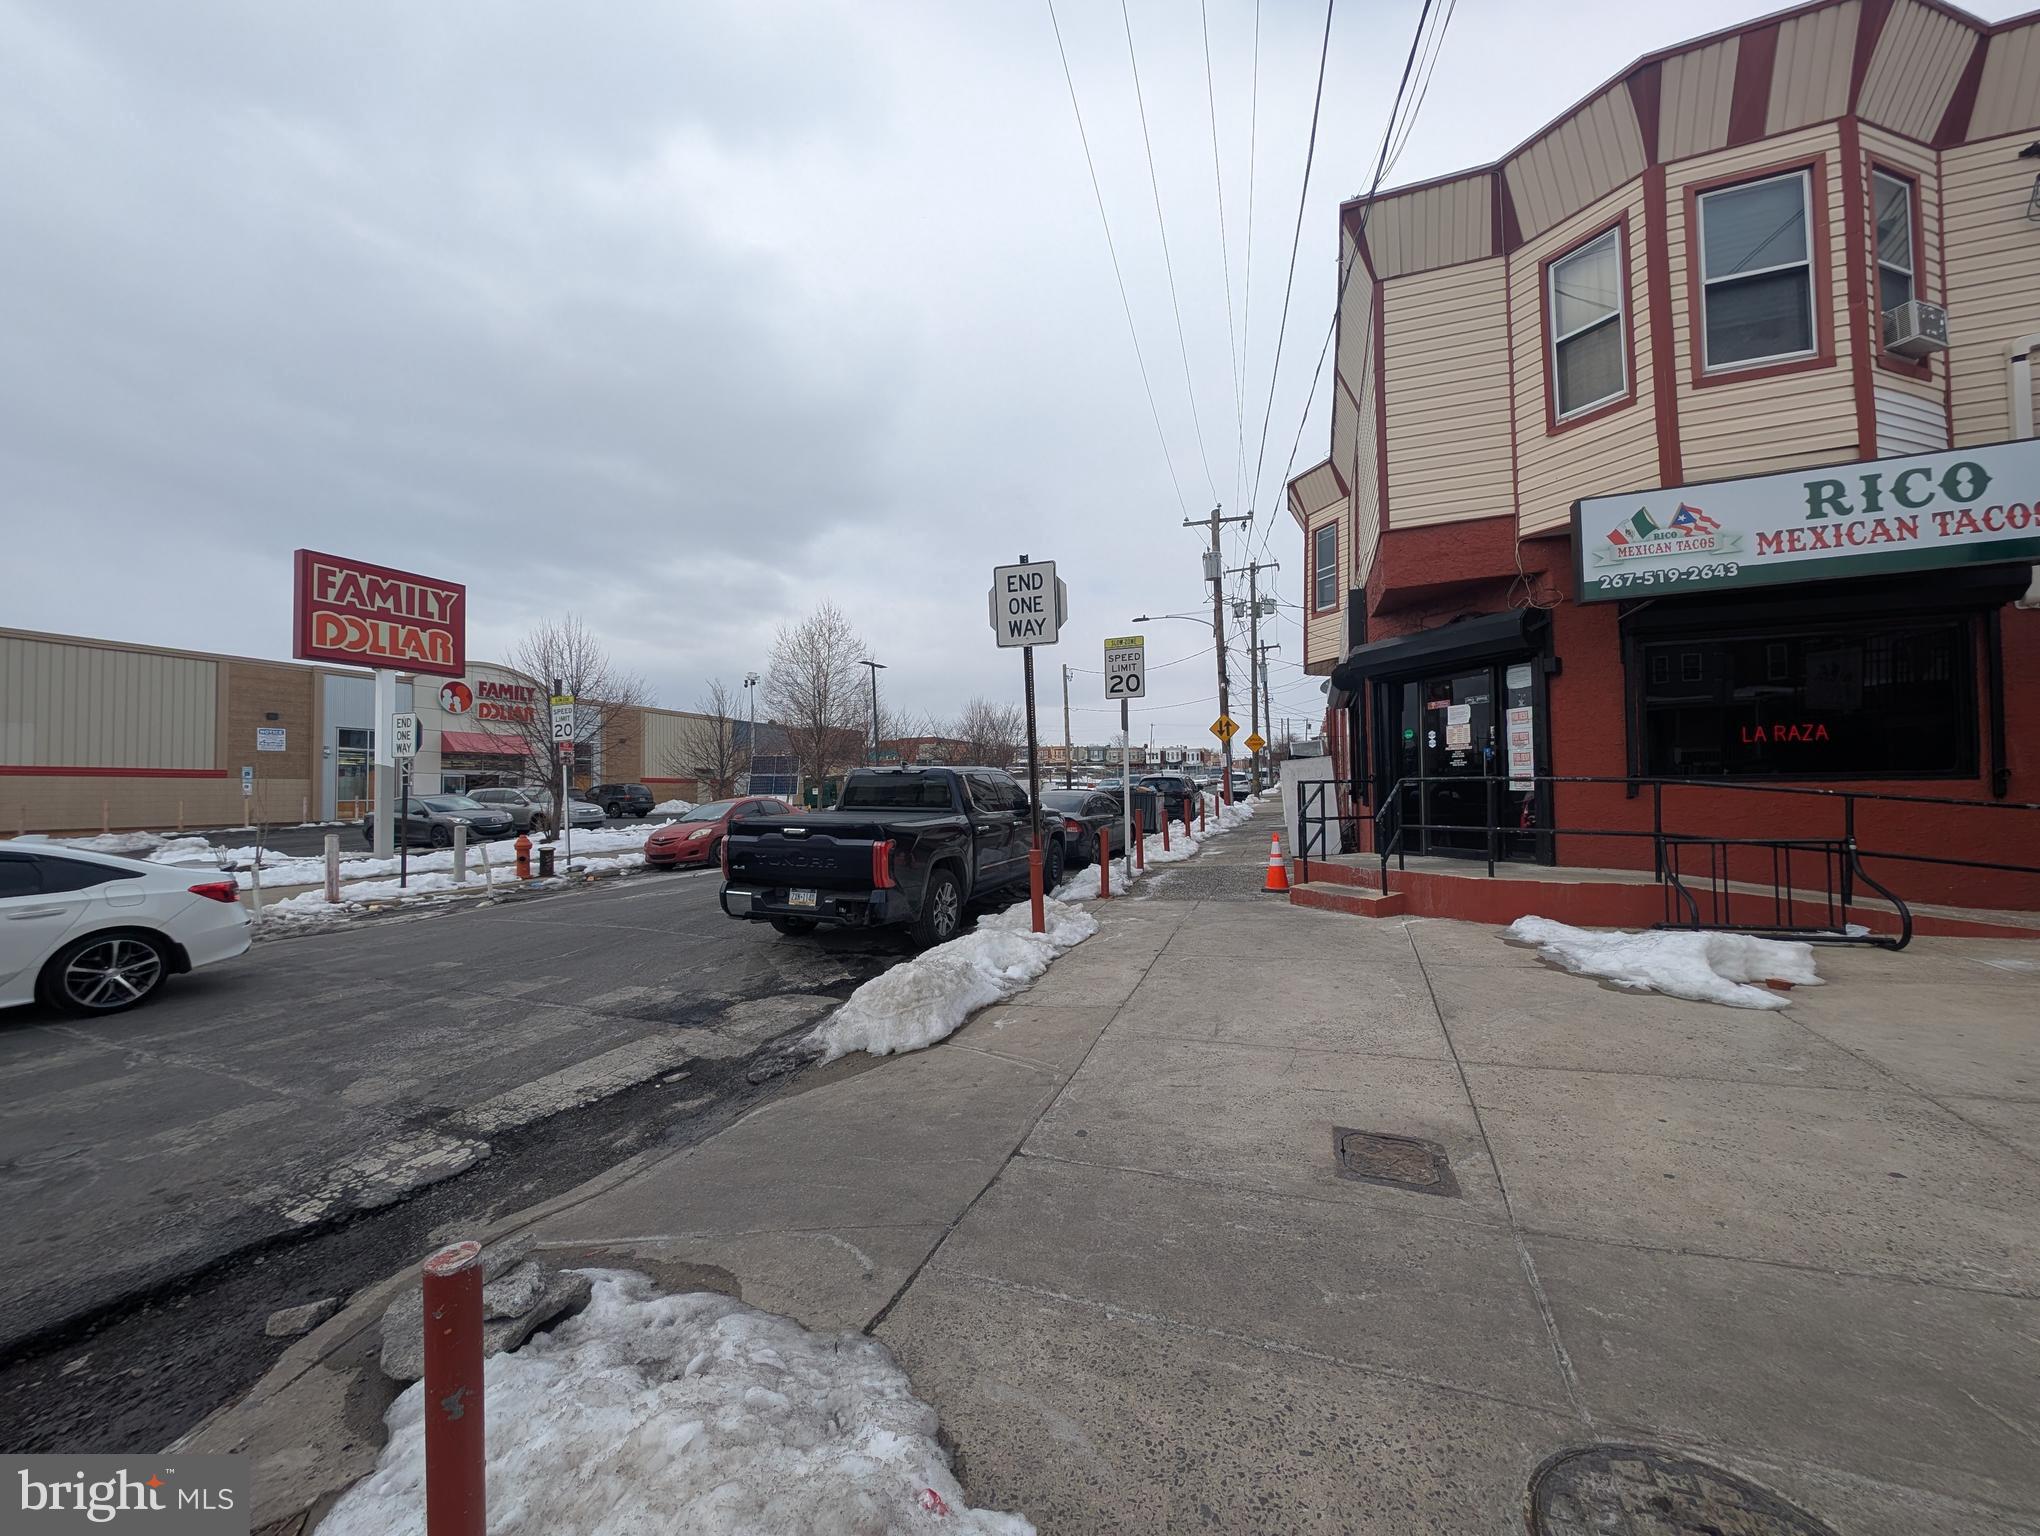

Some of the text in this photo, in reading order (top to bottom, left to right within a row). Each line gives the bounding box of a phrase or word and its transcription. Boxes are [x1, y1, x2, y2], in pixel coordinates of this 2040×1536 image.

[1803, 461, 1993, 520] RICO
[1653, 531, 1678, 541] RICO
[1756, 515, 1919, 556] MEXICAN
[1617, 537, 1715, 557] MEXICAN TACOS
[1007, 572, 1043, 593] END
[1600, 563, 1739, 589] 267-519-2643
[313, 563, 459, 624] FAMILY
[1008, 596, 1044, 615] ONE
[1008, 618, 1046, 638] WAY
[312, 610, 454, 666] DOLLAR
[1111, 638, 1124, 647] SLOW
[1108, 652, 1141, 663] SPEED
[1111, 663, 1137, 673] LIMIT
[477, 680, 537, 702] FAMILY
[1109, 674, 1141, 693] 20
[477, 702, 536, 723] DOLLAR
[553, 707, 573, 716] SPEED
[555, 715, 571, 723] LIMIT
[396, 717, 412, 729] END
[554, 723, 573, 738] 20
[396, 730, 412, 741] ONE
[1741, 723, 1830, 743] LA RAZA
[396, 743, 412, 753] WAY
